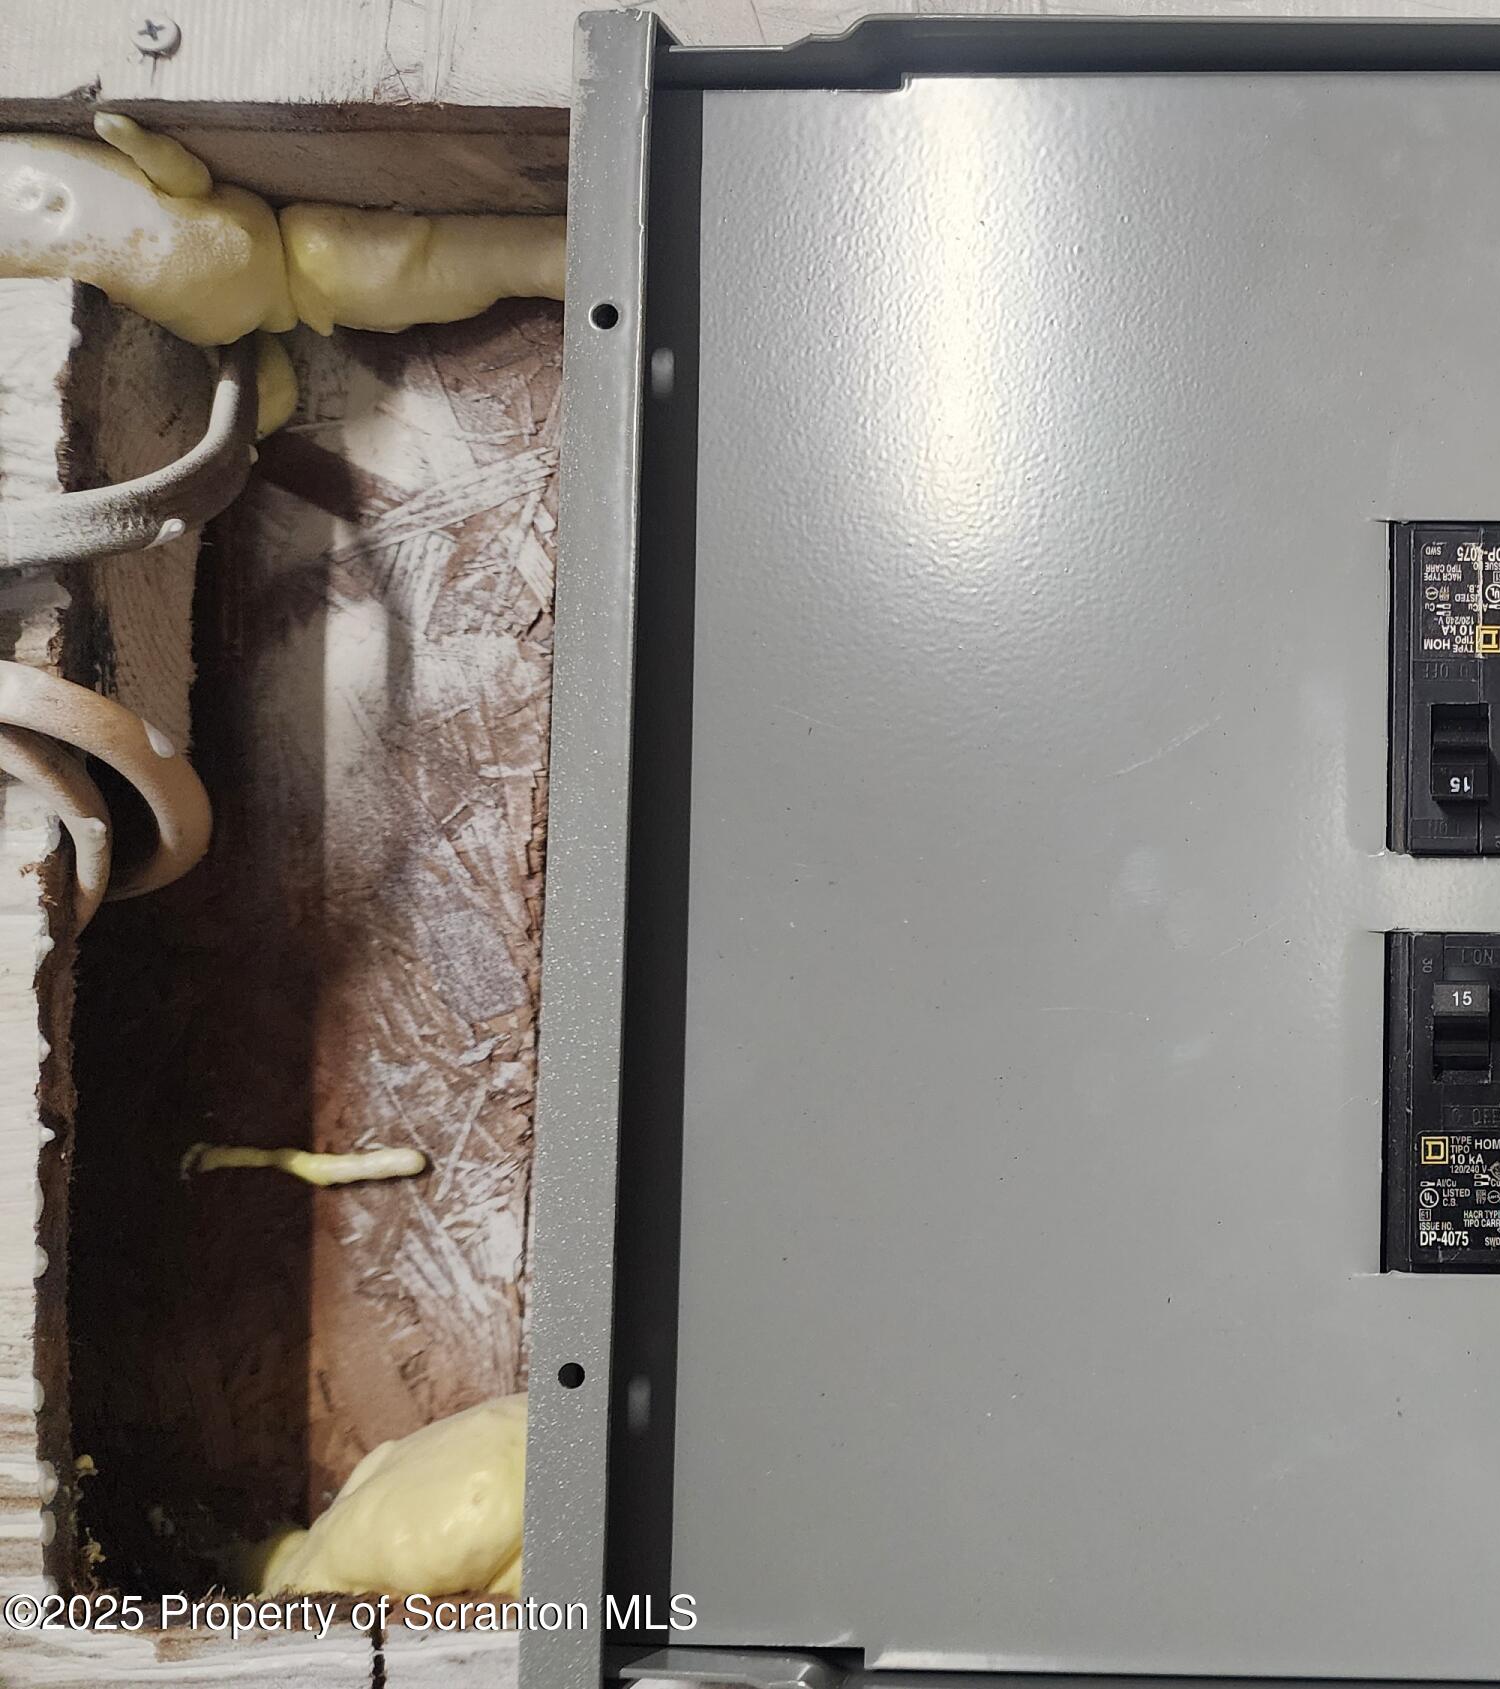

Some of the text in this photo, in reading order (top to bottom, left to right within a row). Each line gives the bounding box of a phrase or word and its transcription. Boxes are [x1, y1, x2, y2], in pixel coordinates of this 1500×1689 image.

[1425, 546, 1441, 555] SWD
[1425, 564, 1462, 572] TIPO CARR
[1443, 573, 1462, 581] HACR
[1446, 616, 1474, 624] 120/240
[1441, 625, 1473, 635] 10 kA
[1455, 636, 1473, 644] TIPO
[1424, 639, 1450, 650] HOM
[1453, 644, 1474, 653] TYPE
[1450, 776, 1470, 792] 15
[1473, 949, 1493, 965] ON
[1452, 991, 1472, 1006] 15
[1450, 1136, 1472, 1144] TYPE
[1451, 1145, 1469, 1153] TIPO
[1451, 1154, 1483, 1164] 10 kA
[1450, 1165, 1479, 1173] 120/240
[1443, 1189, 1470, 1197] LISTED
[1420, 1222, 1439, 1230] ISSUE
[1464, 1219, 1500, 1227] TIPO CARR
[1420, 1231, 1469, 1246] DP-4075
[1485, 1237, 1500, 1246] SWD
